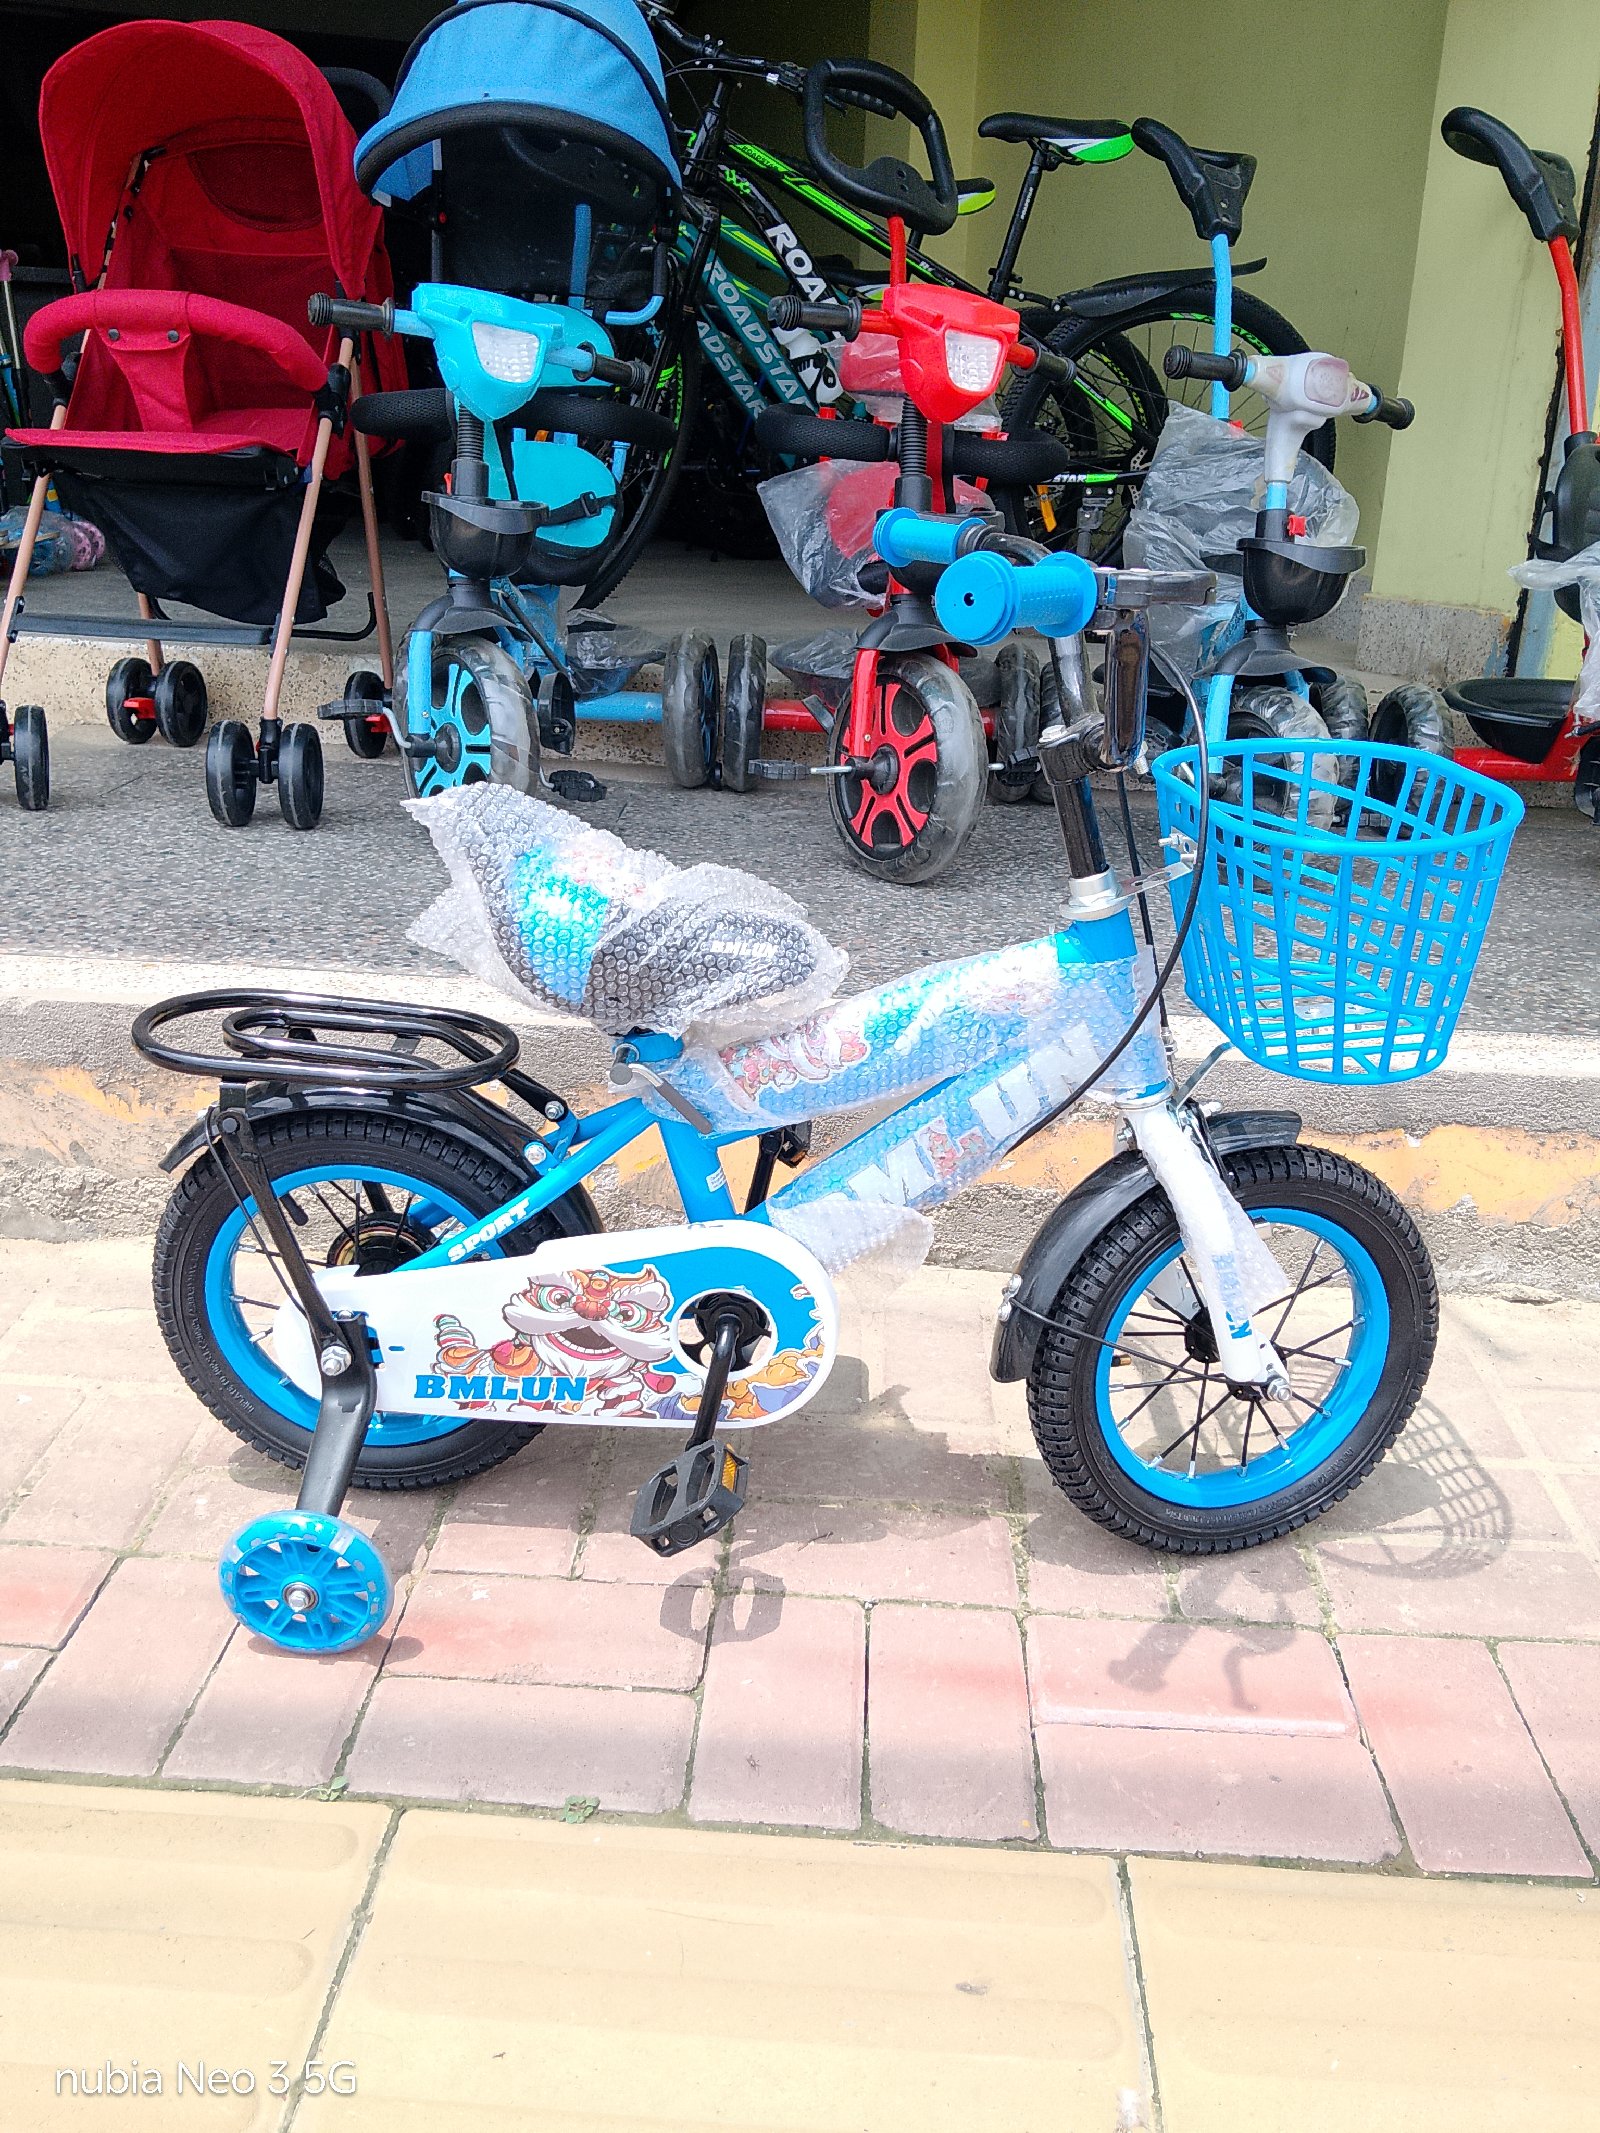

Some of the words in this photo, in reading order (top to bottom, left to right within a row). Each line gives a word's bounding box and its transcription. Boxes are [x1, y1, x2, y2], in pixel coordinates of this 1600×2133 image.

[766, 223, 839, 305] ROA
[447, 1196, 530, 1262] SPORT
[414, 1374, 587, 1401] BMLUN
